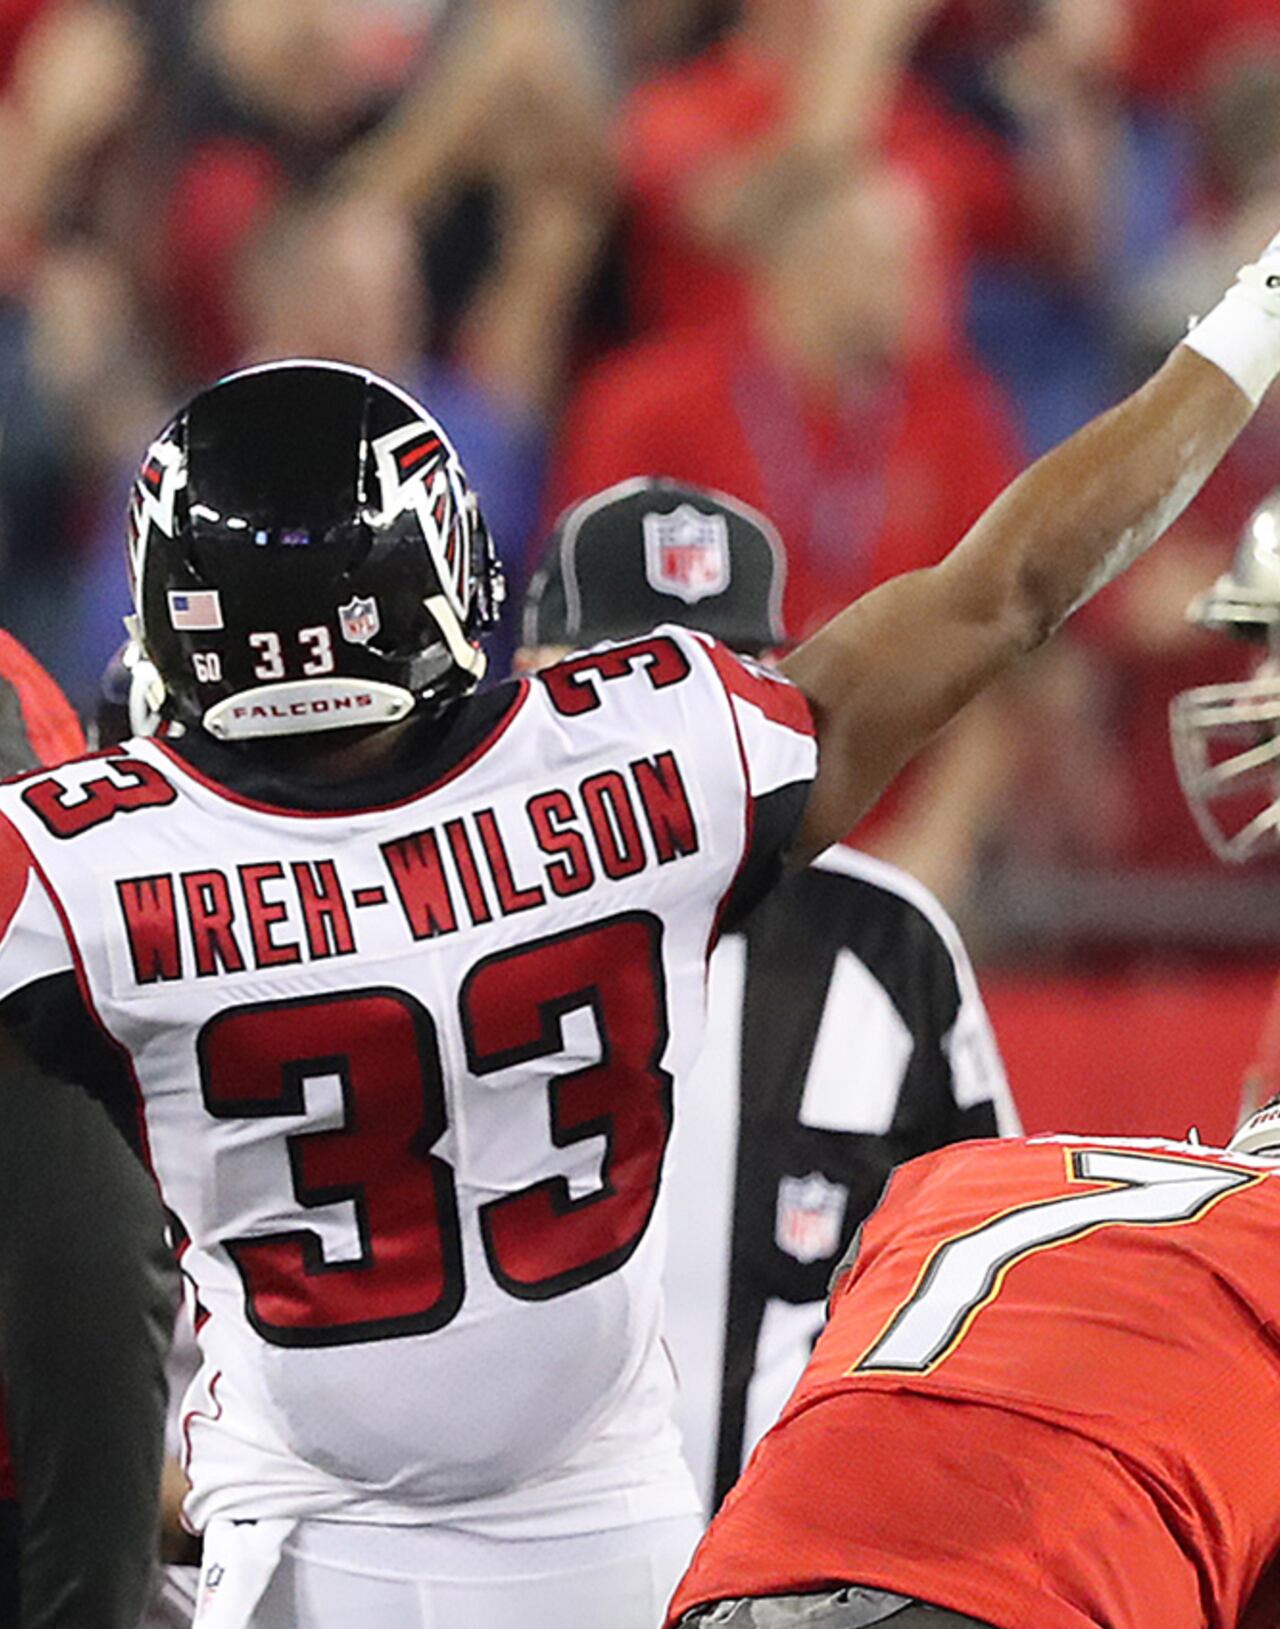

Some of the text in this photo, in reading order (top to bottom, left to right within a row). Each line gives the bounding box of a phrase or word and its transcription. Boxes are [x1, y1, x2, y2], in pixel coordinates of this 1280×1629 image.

[192, 652, 222, 683] 60
[232, 693, 373, 719] FALCONS
[248, 626, 335, 680] 33
[115, 750, 702, 985] WREH-WILSON
[195, 909, 675, 1349] 33
[841, 1148, 1270, 1377] 7
